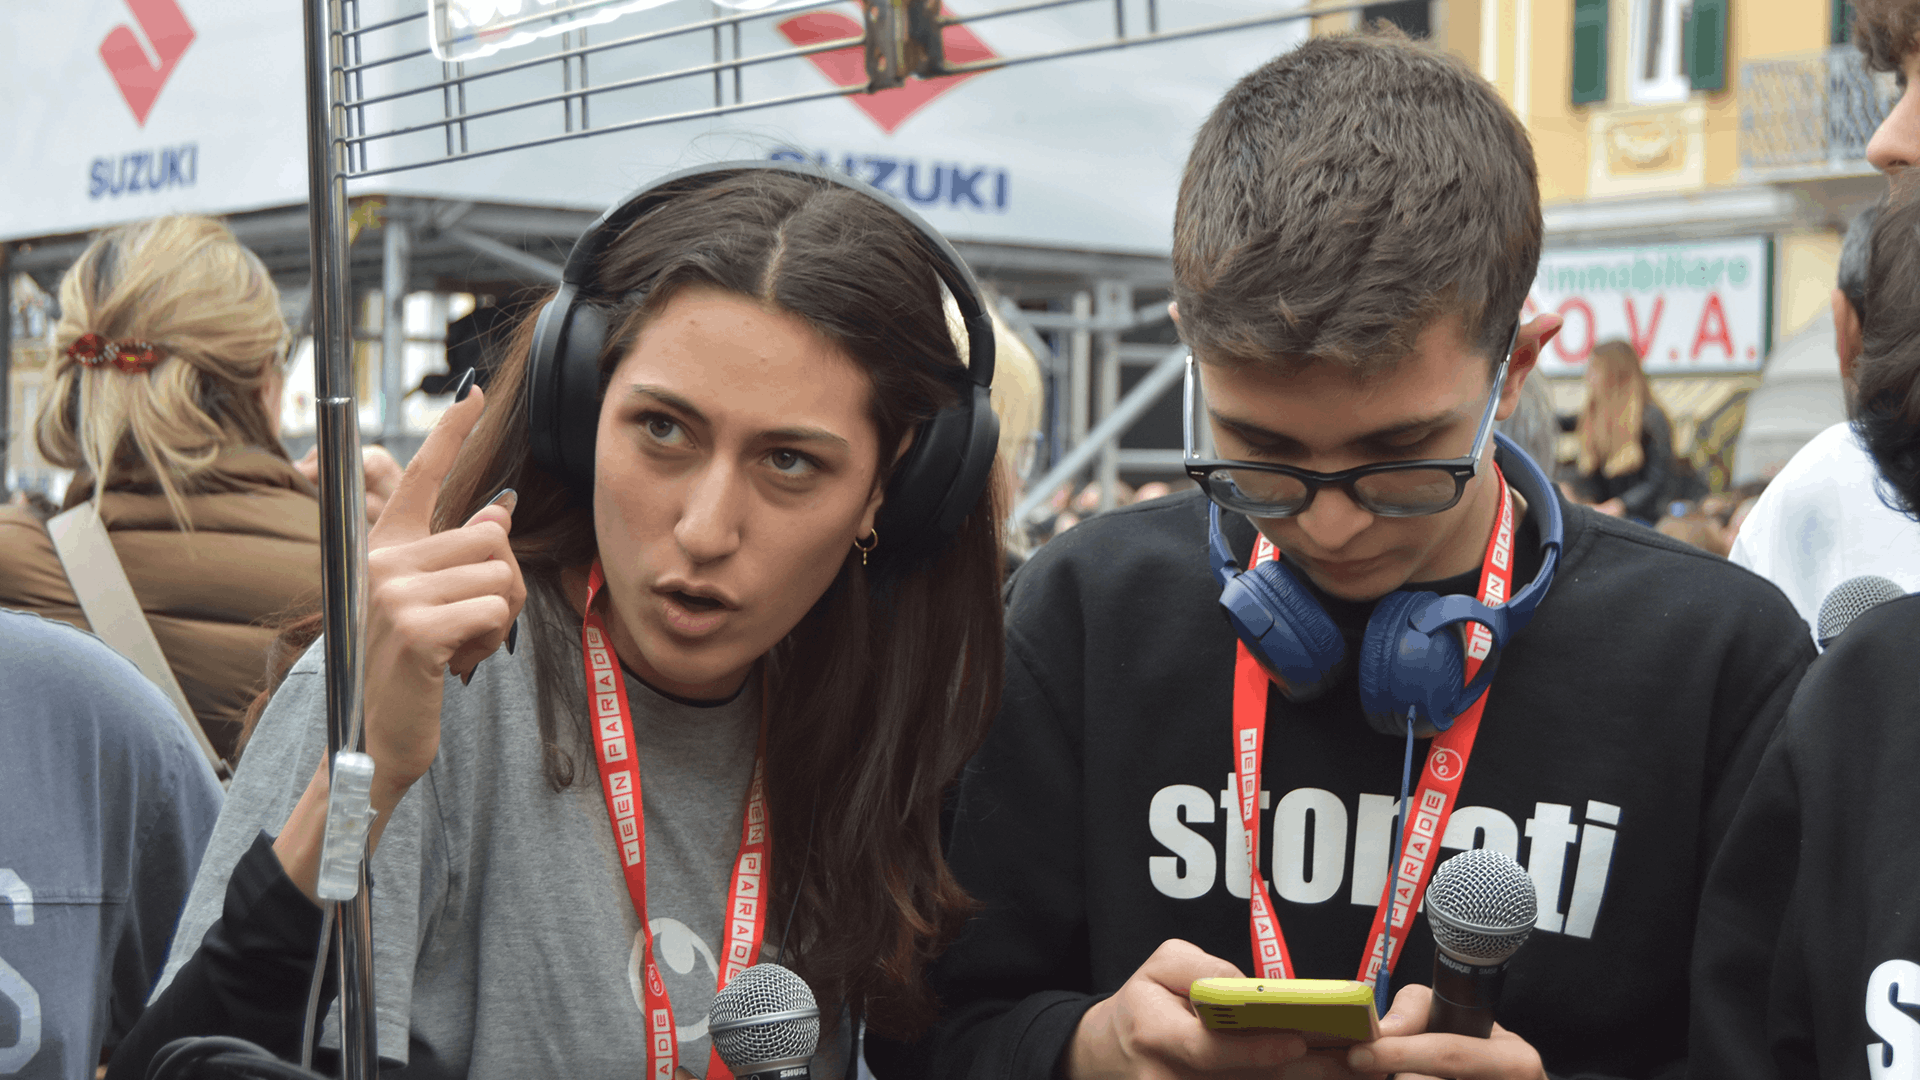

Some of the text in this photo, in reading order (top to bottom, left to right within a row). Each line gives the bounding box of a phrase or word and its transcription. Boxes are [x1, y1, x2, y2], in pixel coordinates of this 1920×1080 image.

[88, 144, 198, 199] SUZUKI
[769, 149, 1011, 213] ZUKI
[588, 629, 640, 864] TEEN PARADE
[1242, 731, 1286, 978] TEEN RADE
[1387, 791, 1444, 926] PARADE
[1438, 953, 1471, 974] SHURE
[780, 1067, 807, 1078] SHURE
